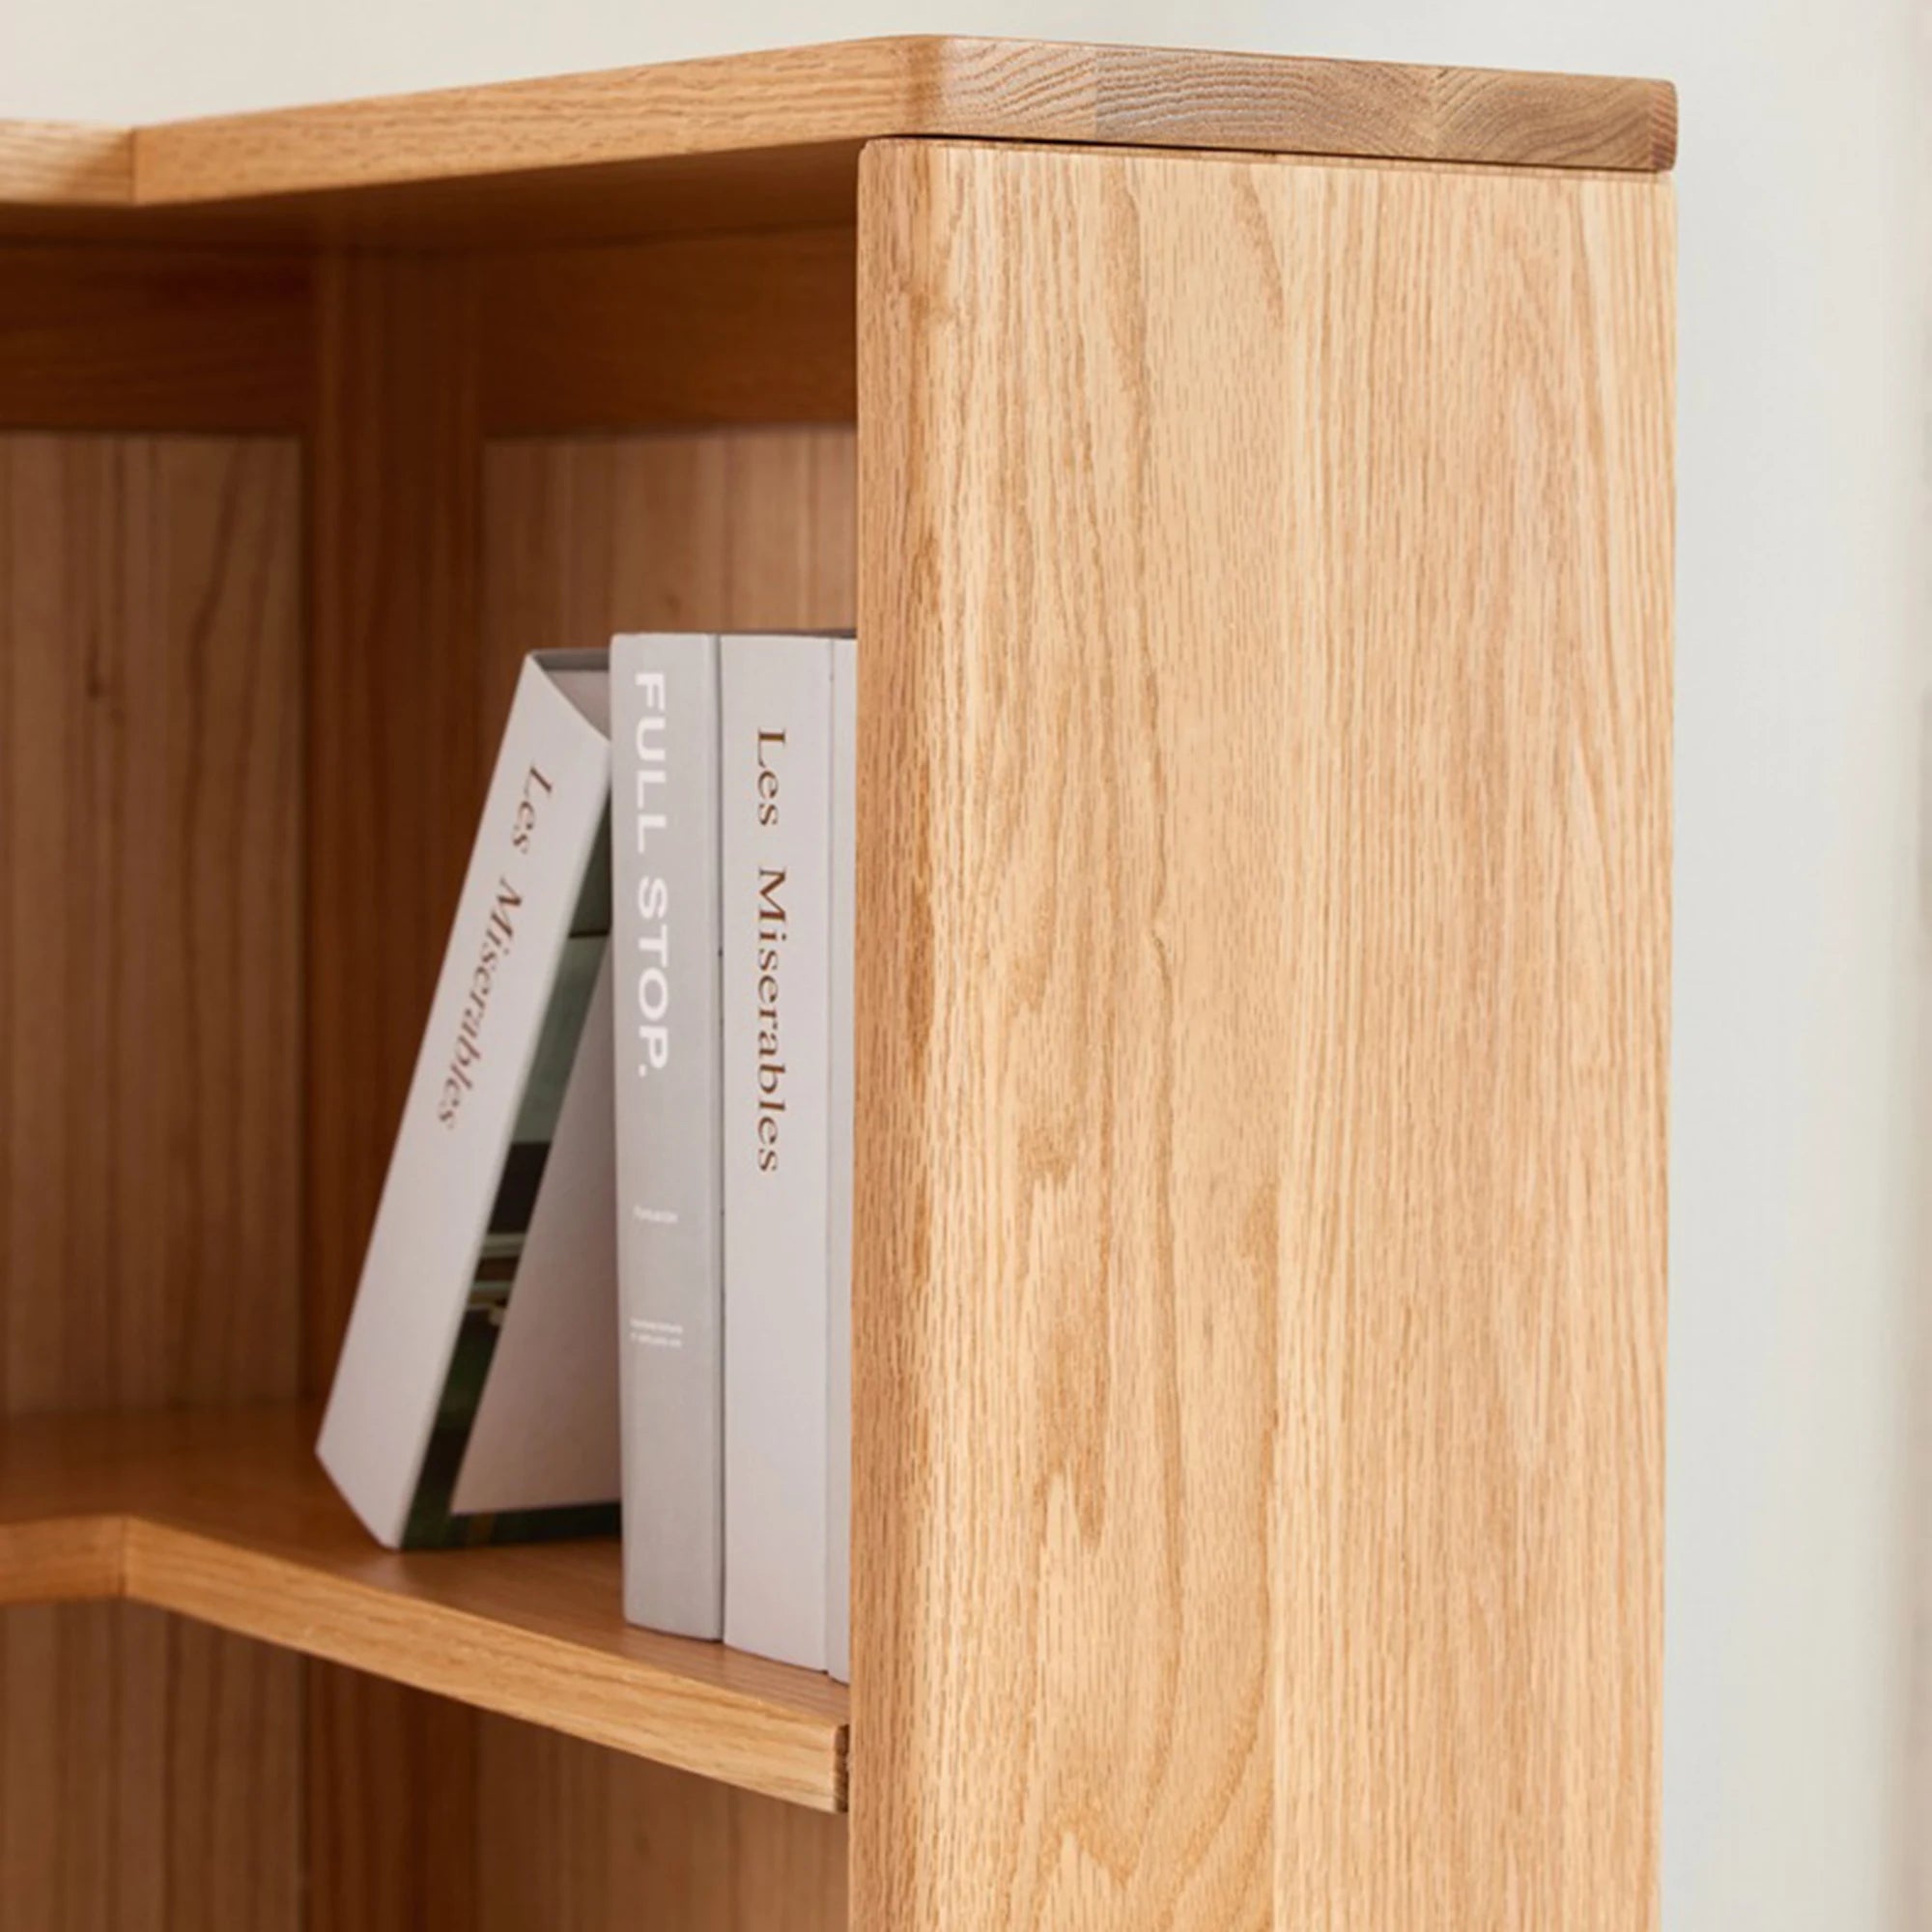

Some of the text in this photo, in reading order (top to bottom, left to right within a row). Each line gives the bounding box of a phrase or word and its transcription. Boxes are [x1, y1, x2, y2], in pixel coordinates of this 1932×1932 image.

[438, 765, 554, 1131] Les Miserables
[635, 672, 668, 1078] FULL STOP.
[757, 726, 787, 1173] Les Miserables
